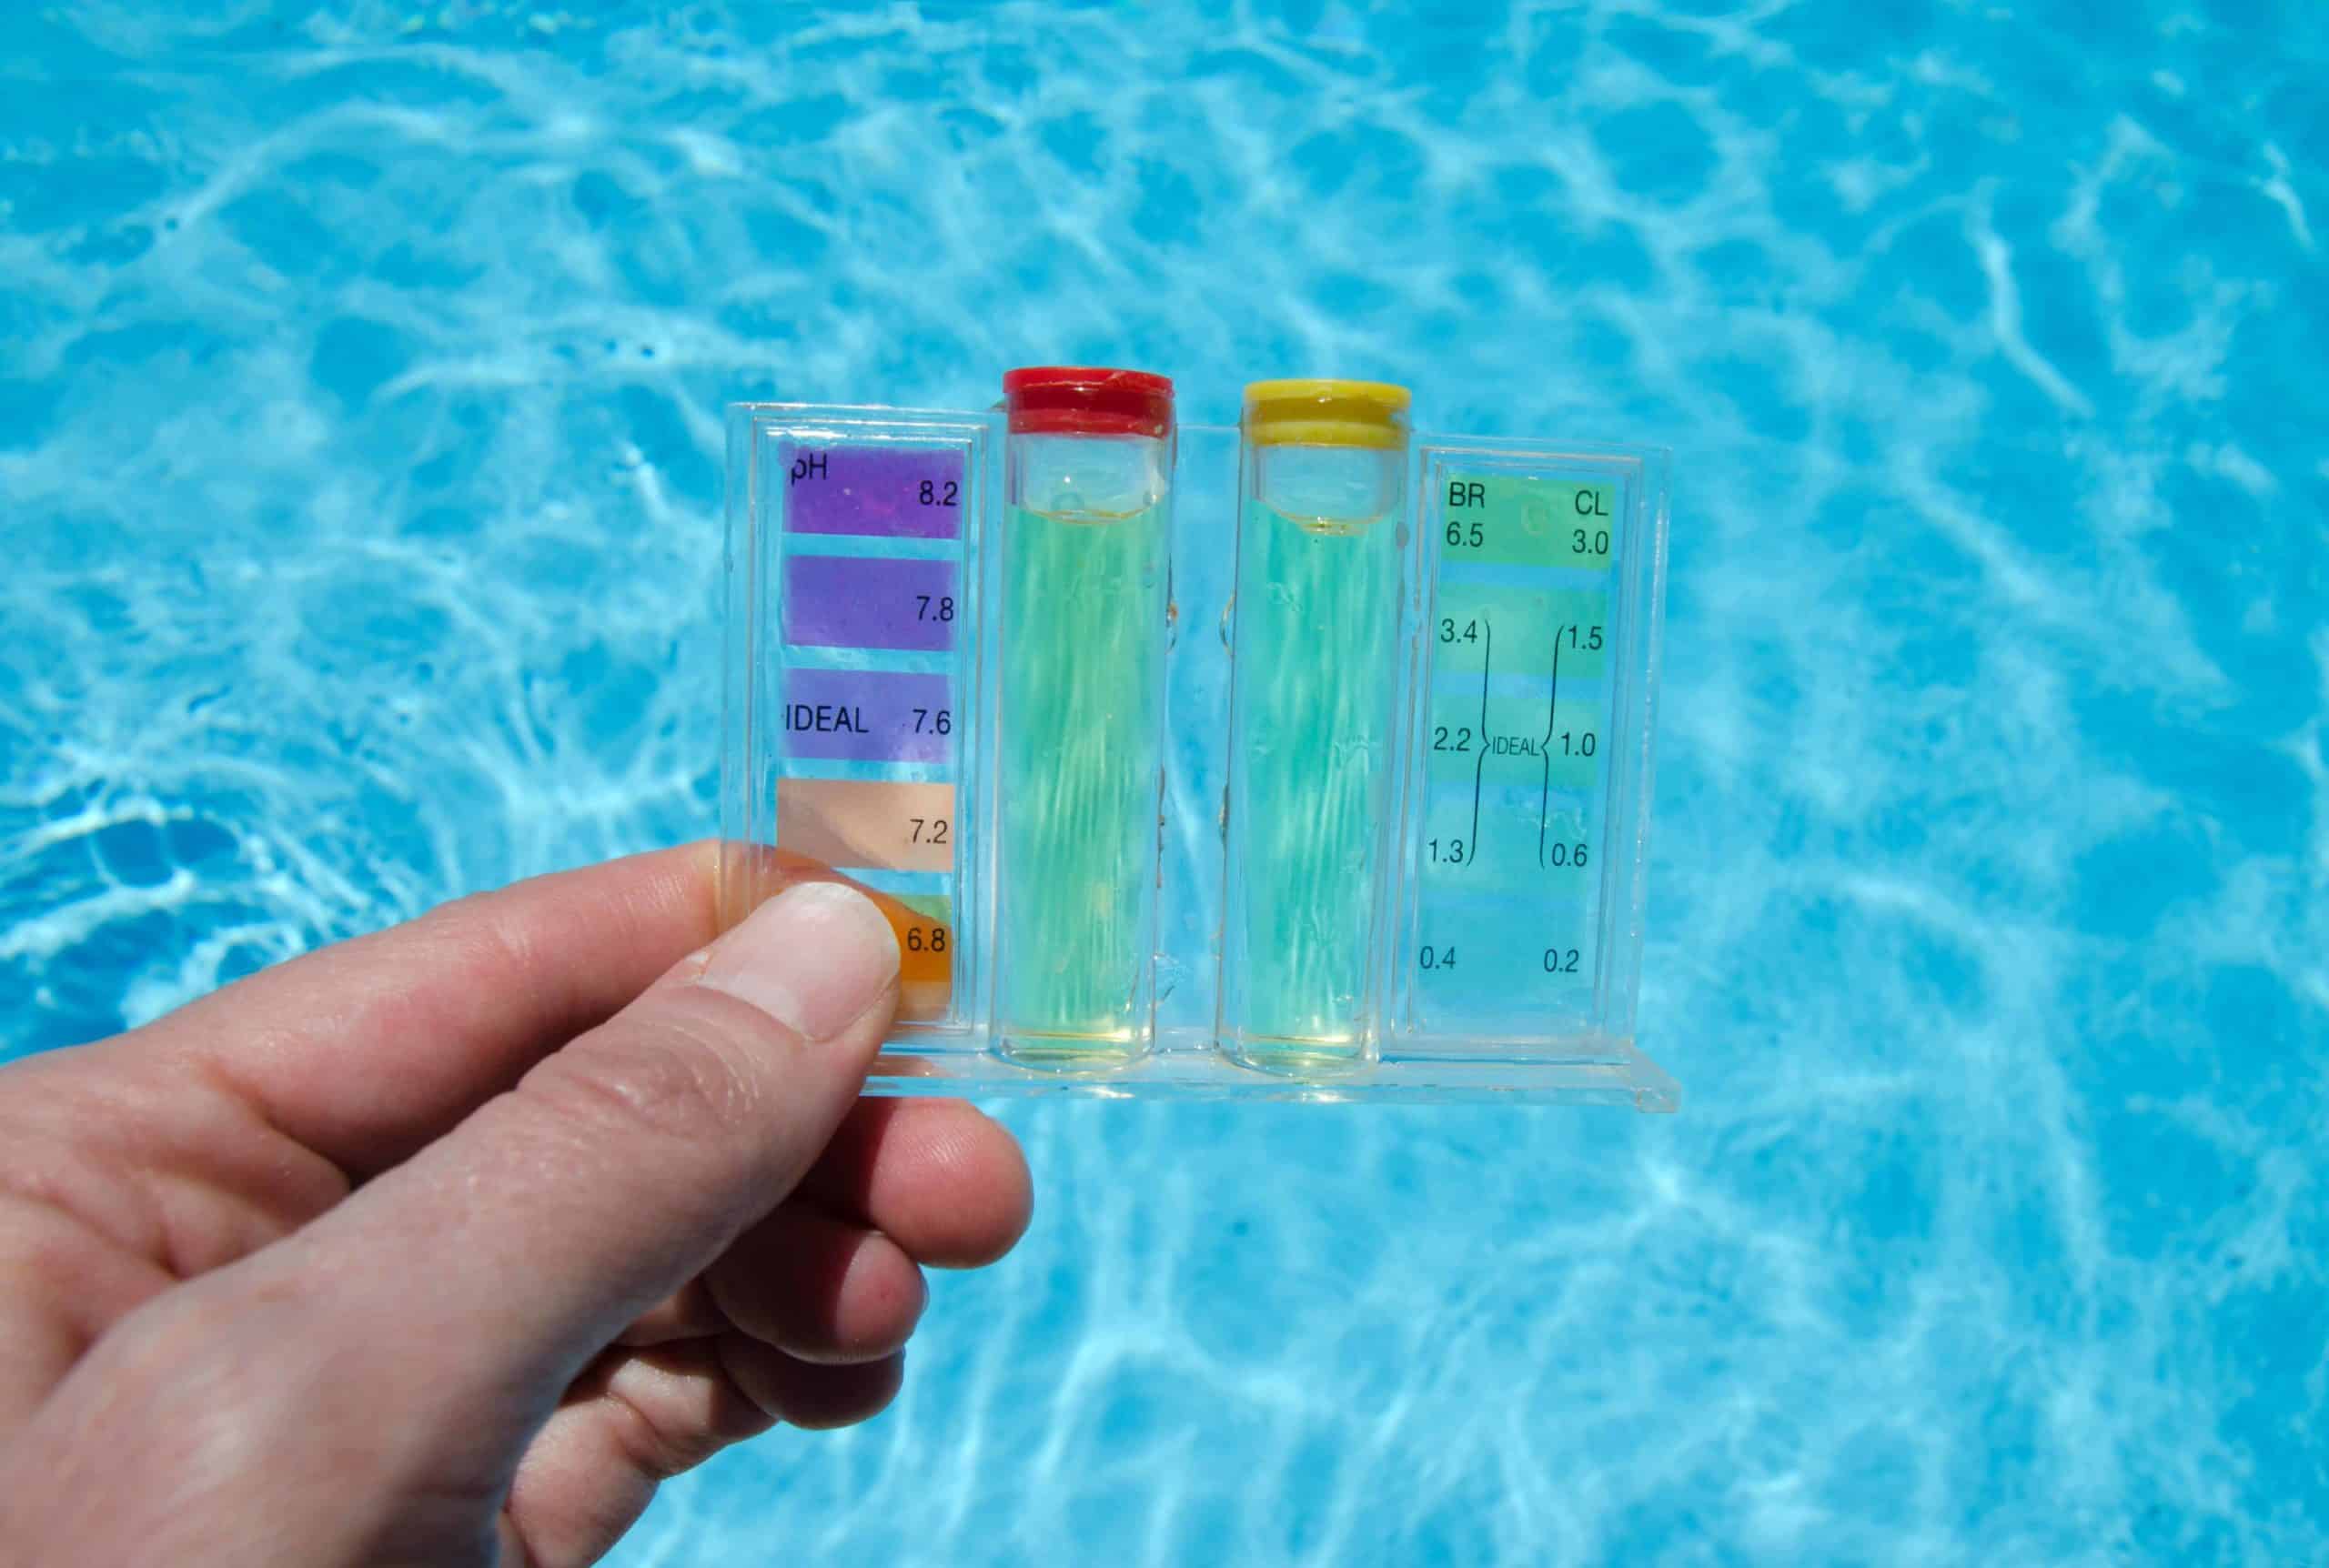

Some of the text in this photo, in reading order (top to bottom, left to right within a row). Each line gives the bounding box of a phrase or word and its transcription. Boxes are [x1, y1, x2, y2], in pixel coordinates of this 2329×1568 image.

[791, 453, 828, 485] pH
[919, 480, 958, 506] 8.2
[1448, 482, 1485, 508] BR
[1575, 490, 1608, 516] CL
[1447, 521, 1483, 548] 6.5
[1572, 529, 1608, 555] 3.0
[916, 596, 954, 621] 7.8
[1440, 618, 1477, 644] 3.4
[1568, 625, 1602, 650] 1.5
[785, 704, 952, 736] IDEAL 7.6
[1433, 727, 1596, 757] 2.2 IDEAL 1.0
[910, 819, 948, 844] 7.2
[1428, 839, 1464, 863] 1.3
[1551, 843, 1588, 867] 0.6
[906, 928, 946, 952] 6.8
[1419, 946, 1456, 970] 0.4
[1544, 949, 1579, 972] 0.2
